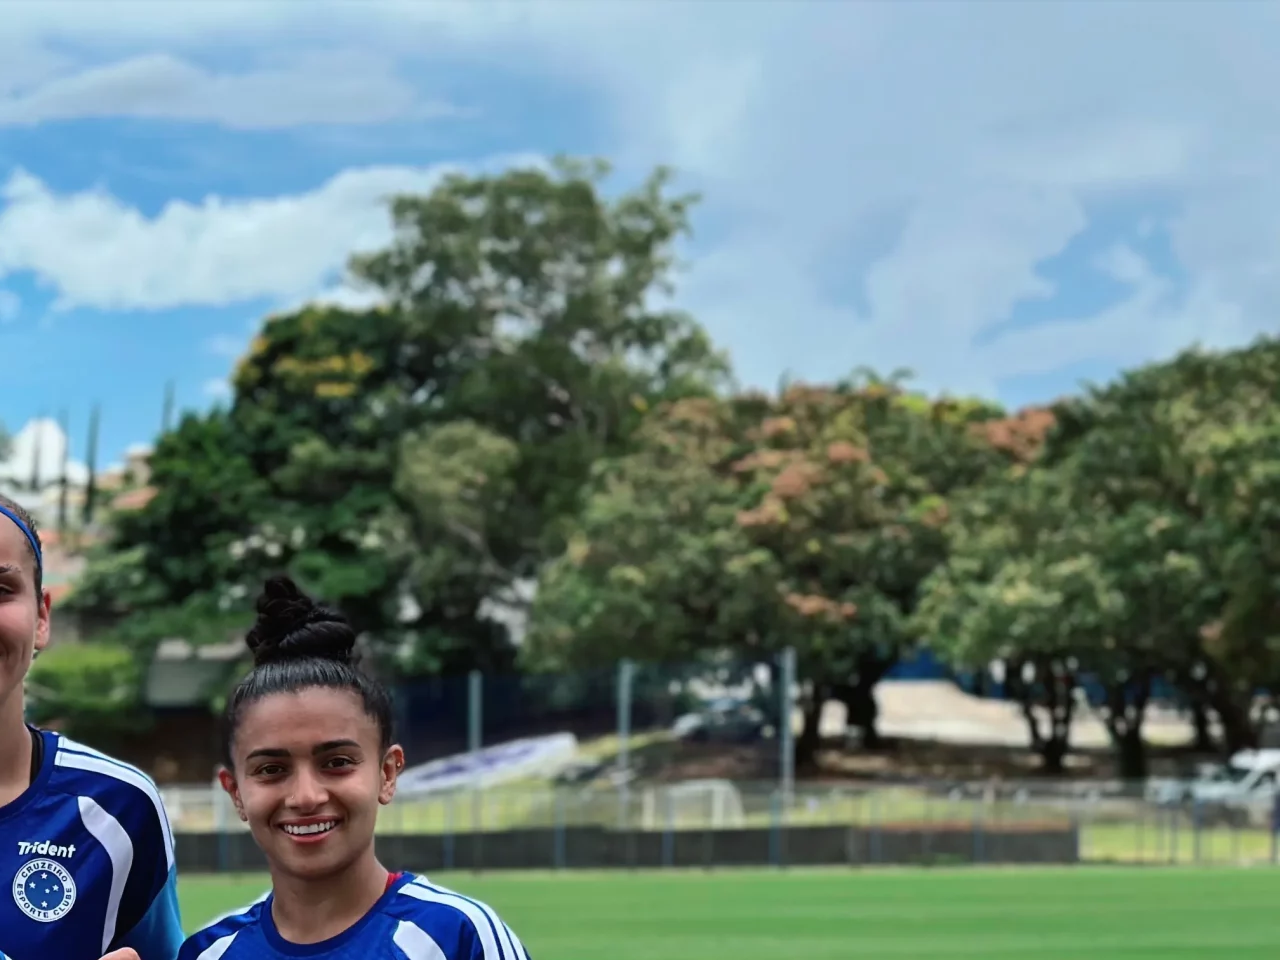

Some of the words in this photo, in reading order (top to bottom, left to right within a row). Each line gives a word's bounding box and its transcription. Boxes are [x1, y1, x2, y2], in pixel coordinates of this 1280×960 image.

[18, 840, 76, 858] Trident
[20, 861, 68, 882] CRUZEIRO
[16, 883, 49, 918] ESPORTE
[53, 887, 72, 916] CLUBE
